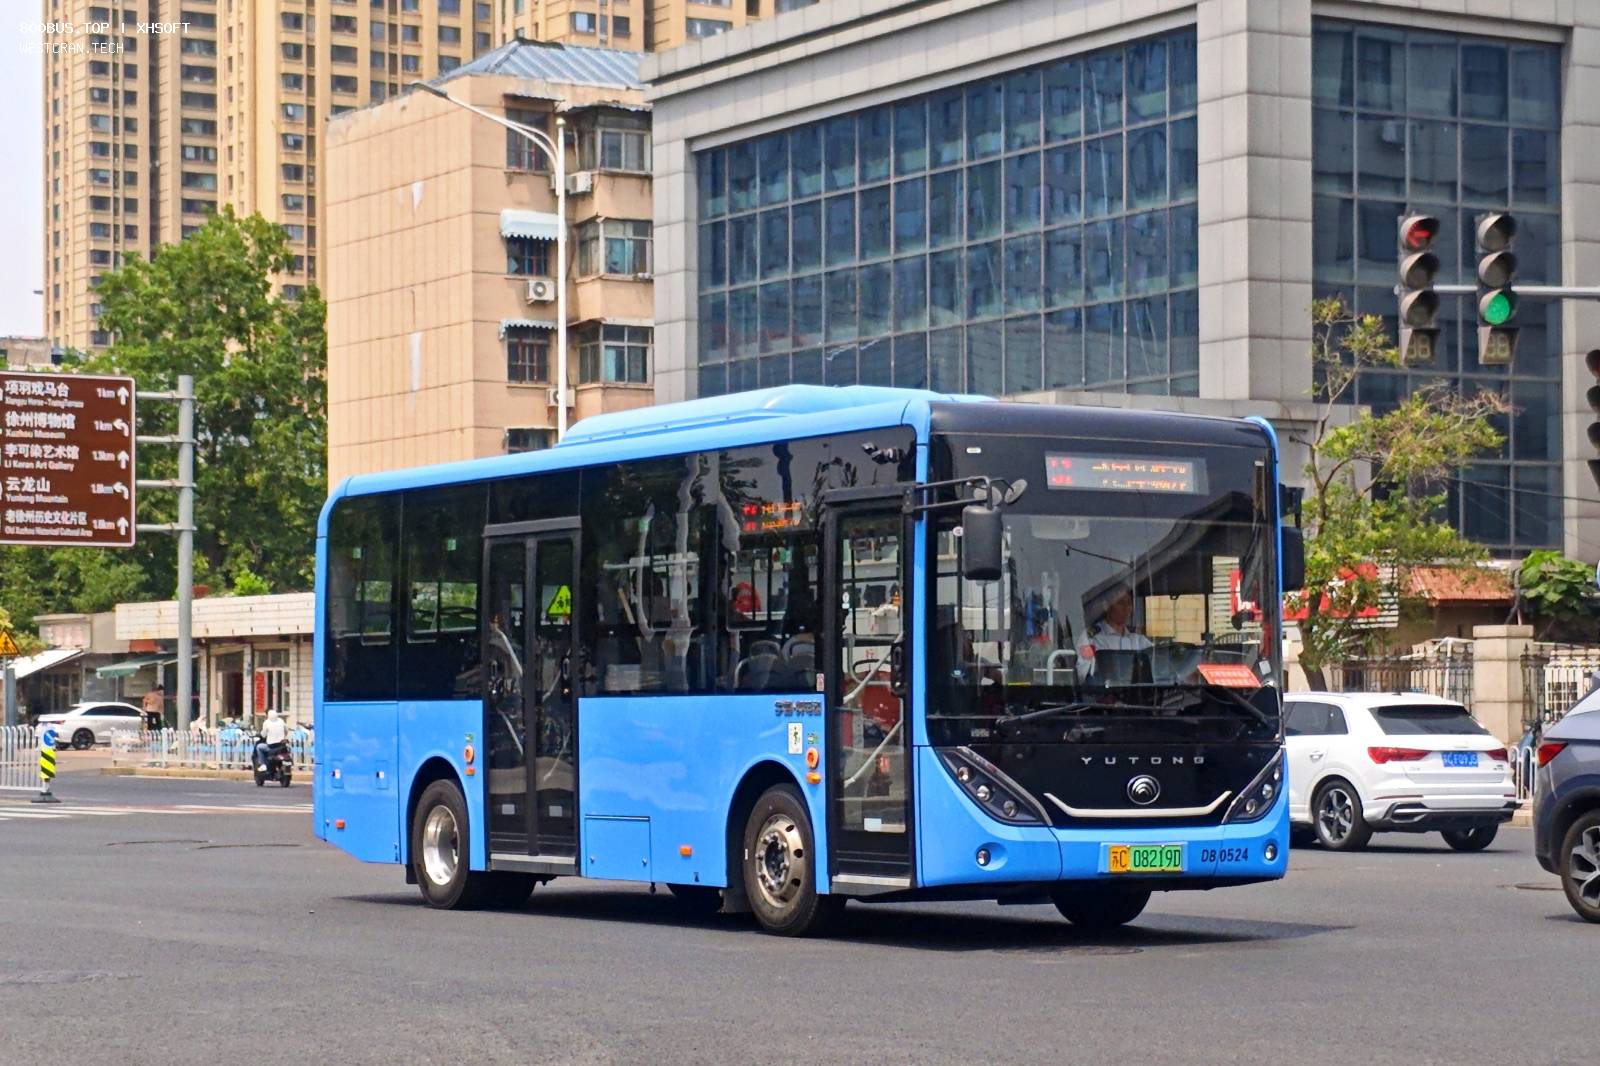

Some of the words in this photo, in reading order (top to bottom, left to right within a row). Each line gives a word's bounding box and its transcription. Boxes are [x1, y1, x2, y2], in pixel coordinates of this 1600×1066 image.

[6, 411, 75, 429] 徐州博物馆
[5, 443, 79, 460] 李可染艺术馆
[6, 476, 50, 493] 云龙山
[1081, 756, 1205, 765] YUTONG
[1219, 847, 1249, 863] 0524
